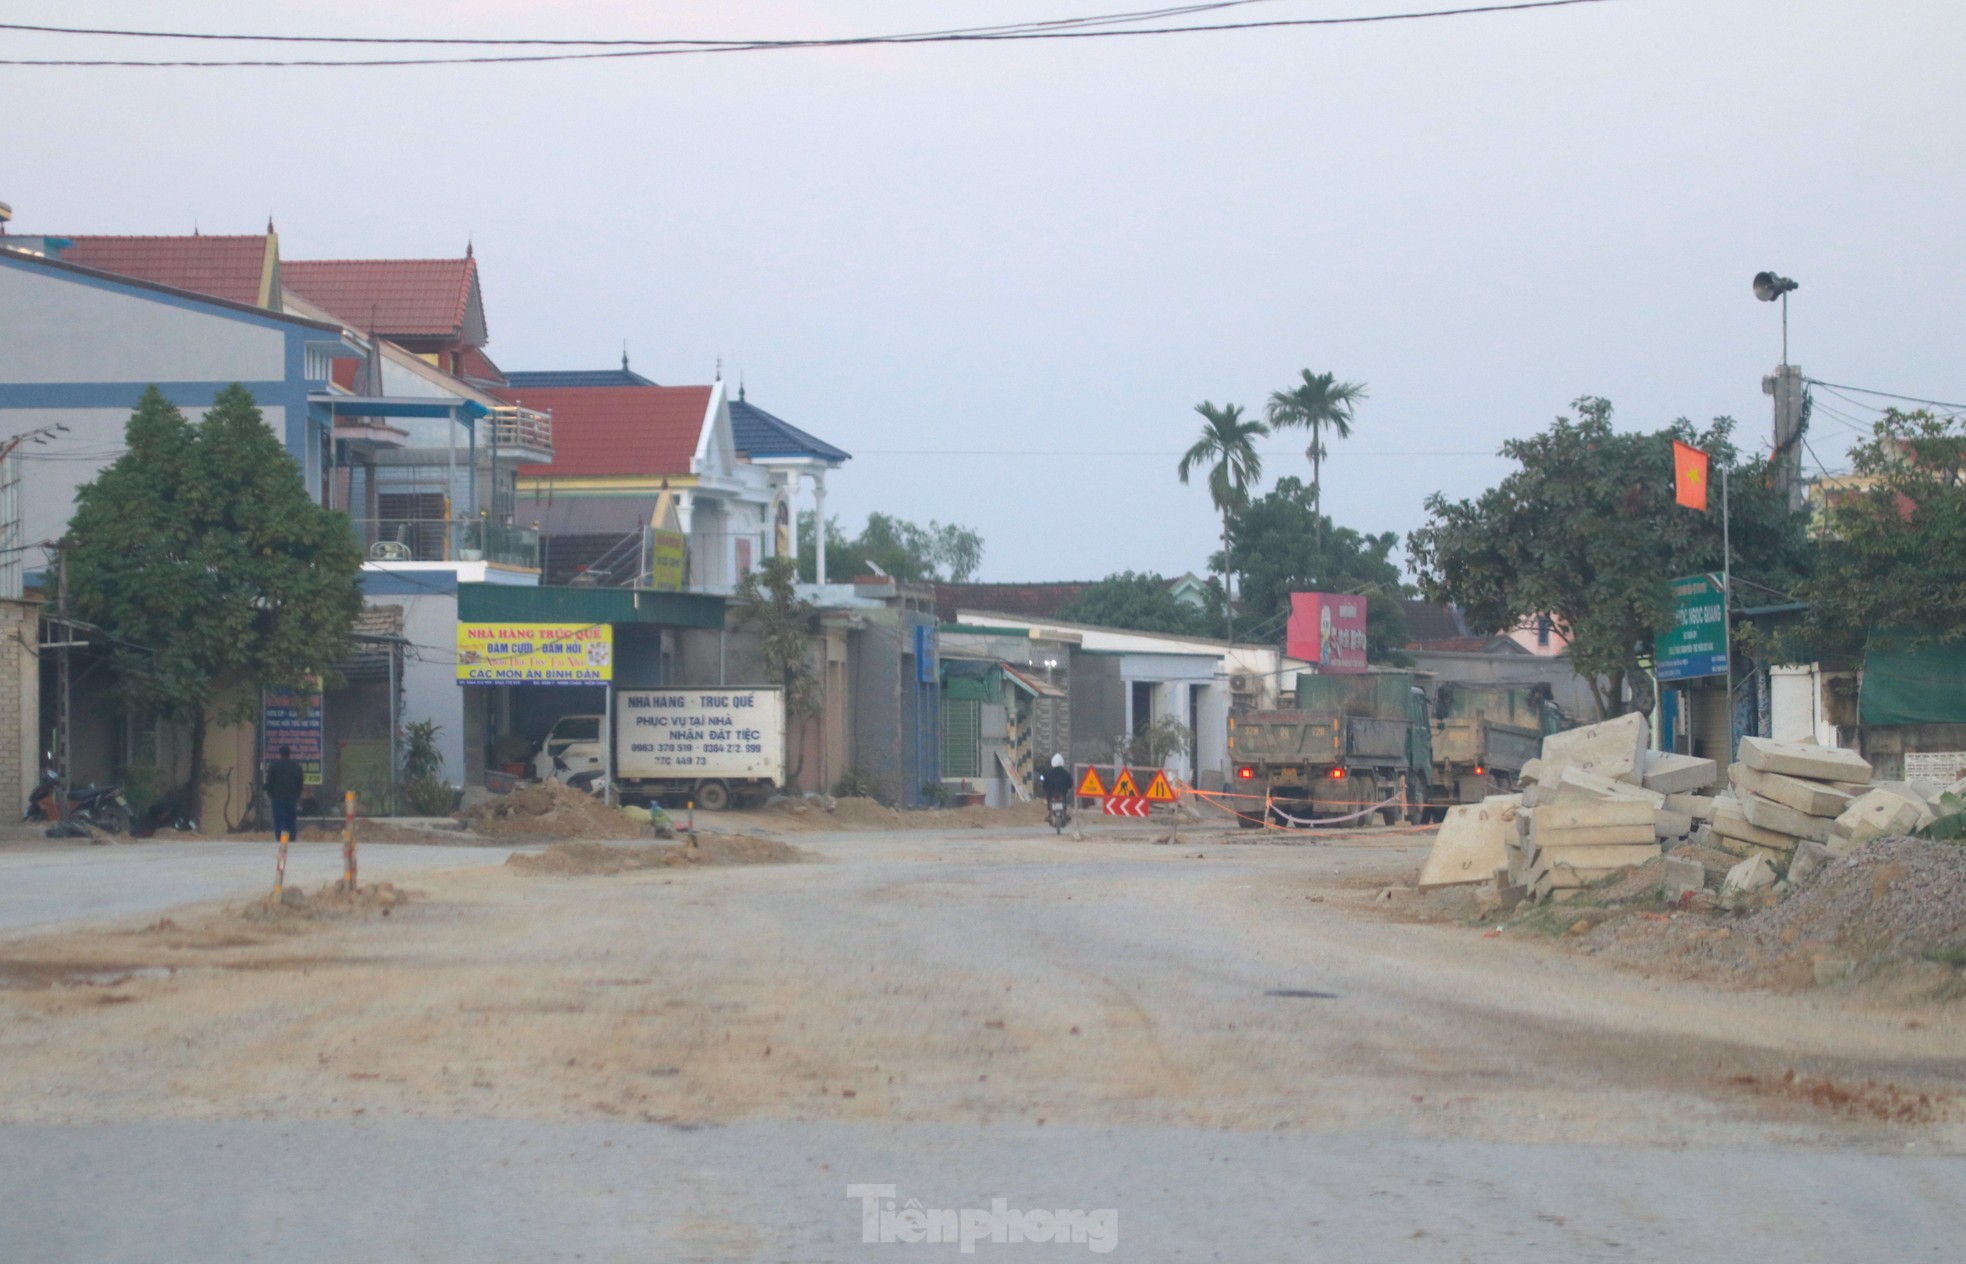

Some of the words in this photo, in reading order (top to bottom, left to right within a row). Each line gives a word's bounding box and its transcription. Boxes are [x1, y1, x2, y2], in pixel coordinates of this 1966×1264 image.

[468, 627, 495, 639] NHÀ
[498, 627, 534, 639] HÀNG
[636, 716, 668, 728] PHỤC
[671, 716, 687, 728] VỤ
[708, 713, 733, 726] NHÀ
[669, 728, 704, 742] NHẬN
[735, 728, 760, 742] TIỆC
